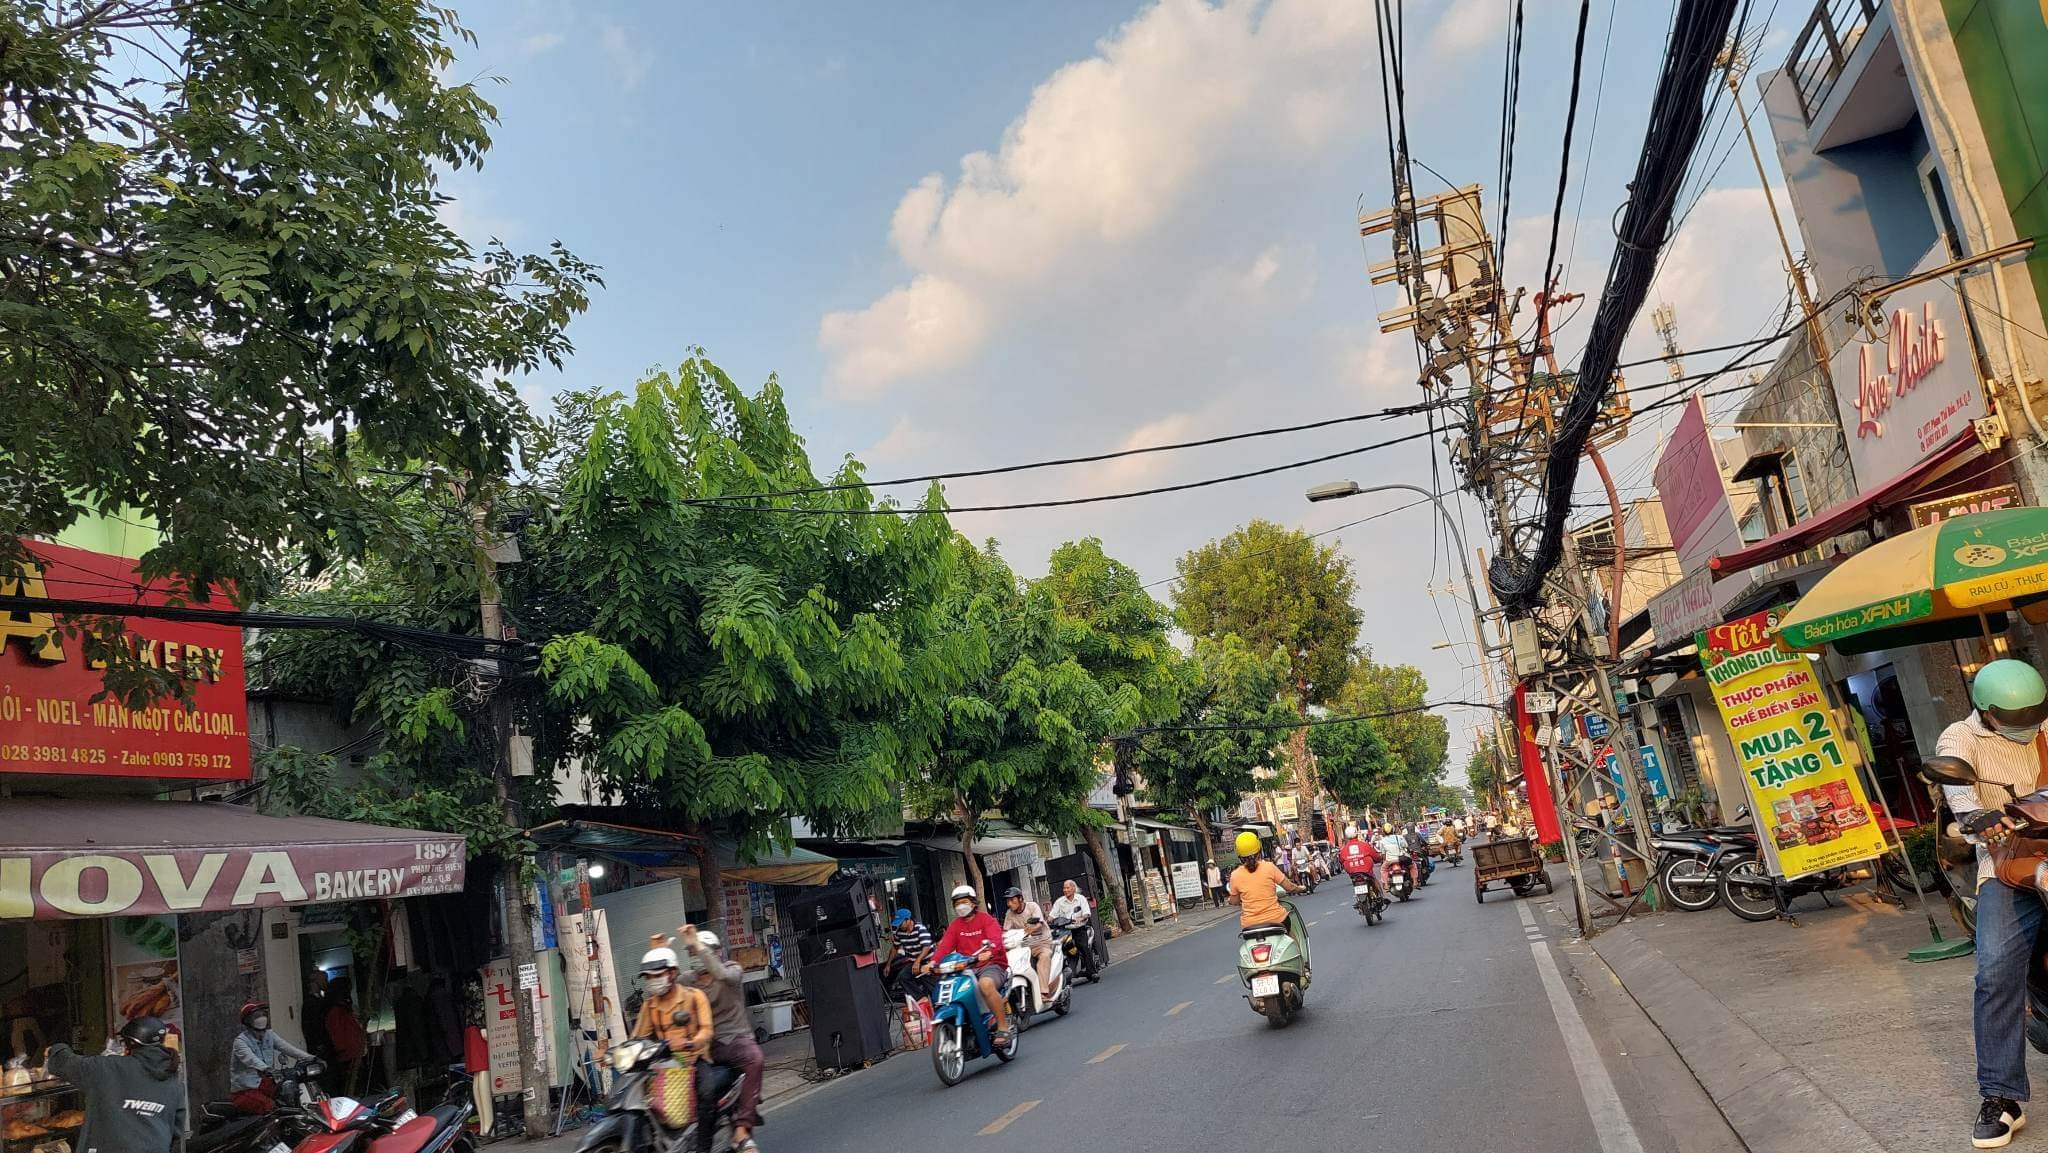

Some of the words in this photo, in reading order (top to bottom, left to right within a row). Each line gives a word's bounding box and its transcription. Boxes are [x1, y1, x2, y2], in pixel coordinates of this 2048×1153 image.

[1969, 584, 1991, 597] RAU
[1716, 619, 1762, 651] Tết
[1804, 620, 1833, 639] Bách
[1836, 613, 1858, 631] hóa
[1861, 597, 1910, 625] XANH
[1711, 650, 1759, 684] KHÔNG
[1757, 650, 1773, 665] LO
[1722, 686, 1763, 708] THỰC
[1764, 671, 1810, 694] PHẨM
[37, 699, 81, 726] NOEL
[93, 698, 128, 734] MẶN
[132, 706, 170, 736] NGỌT
[1730, 709, 1757, 727] CHẾ
[1758, 701, 1790, 719] BIẾN
[1791, 692, 1819, 709] SẴN
[1740, 728, 1804, 760] MUA
[1803, 712, 1831, 741] 2
[1, 745, 29, 761] 028
[33, 746, 68, 762] 3981
[71, 748, 106, 764] 4825
[121, 750, 150, 766] Zalo:
[153, 752, 184, 767] 0903
[187, 753, 208, 768] 759
[212, 755, 232, 769] 172
[1751, 753, 1821, 788] TẶNG
[1821, 740, 1843, 765] 1
[314, 867, 405, 901] BAKERY
